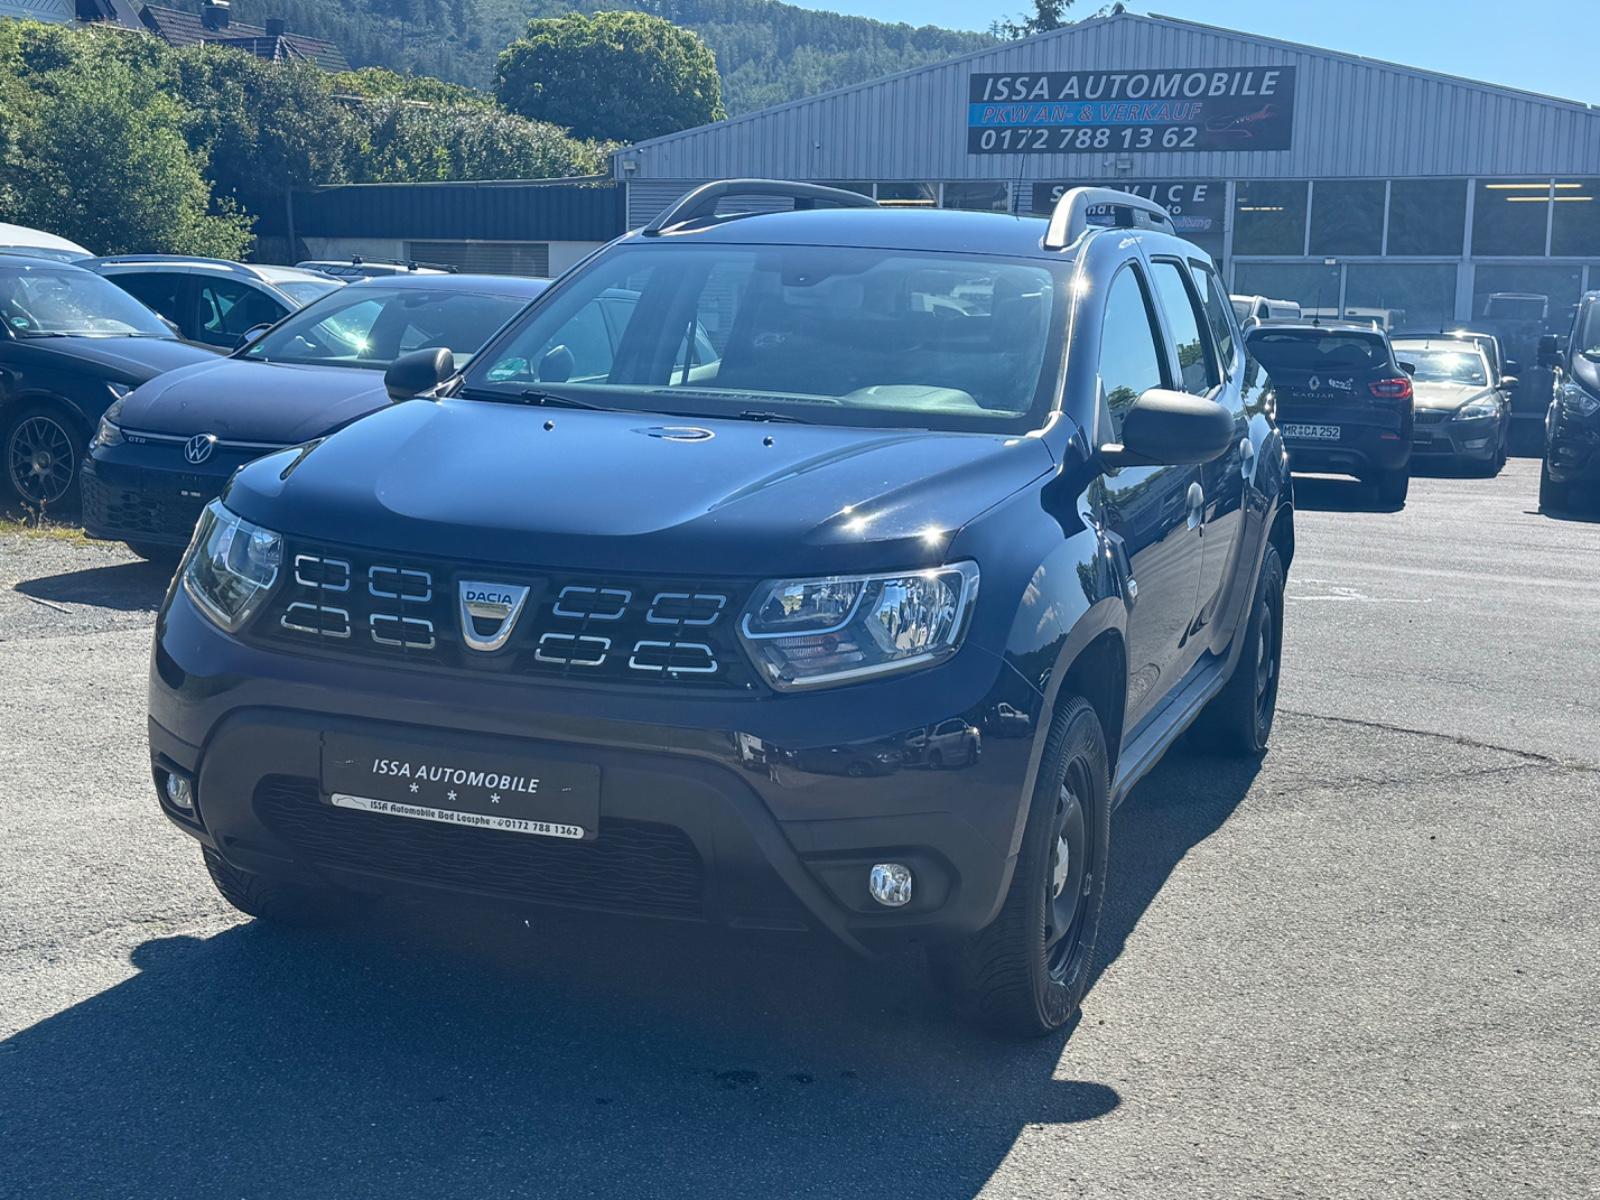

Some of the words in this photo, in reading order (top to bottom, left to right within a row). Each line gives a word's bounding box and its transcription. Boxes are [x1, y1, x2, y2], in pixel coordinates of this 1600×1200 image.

[982, 76, 1050, 101] ISSA
[1058, 71, 1280, 99] AUTOMOBILE
[982, 105, 1032, 122] PKW
[1078, 104, 1093, 121] &
[1101, 102, 1203, 121] VERKAUF
[980, 128, 1050, 149] 0172
[1059, 127, 1111, 149] 788
[1120, 127, 1154, 148] 13
[1162, 126, 1198, 148] 62
[1050, 185, 1208, 203] SVICE
[1319, 427, 1339, 438] 252
[465, 590, 513, 605] DACIA
[372, 758, 411, 778] ISSA
[415, 765, 539, 794] AUTOMOBILE
[370, 800, 388, 812] ISSA
[390, 804, 436, 819] Automobile
[438, 810, 455, 821] Bad
[533, 823, 551, 833] 788
[555, 826, 578, 836] 1362
